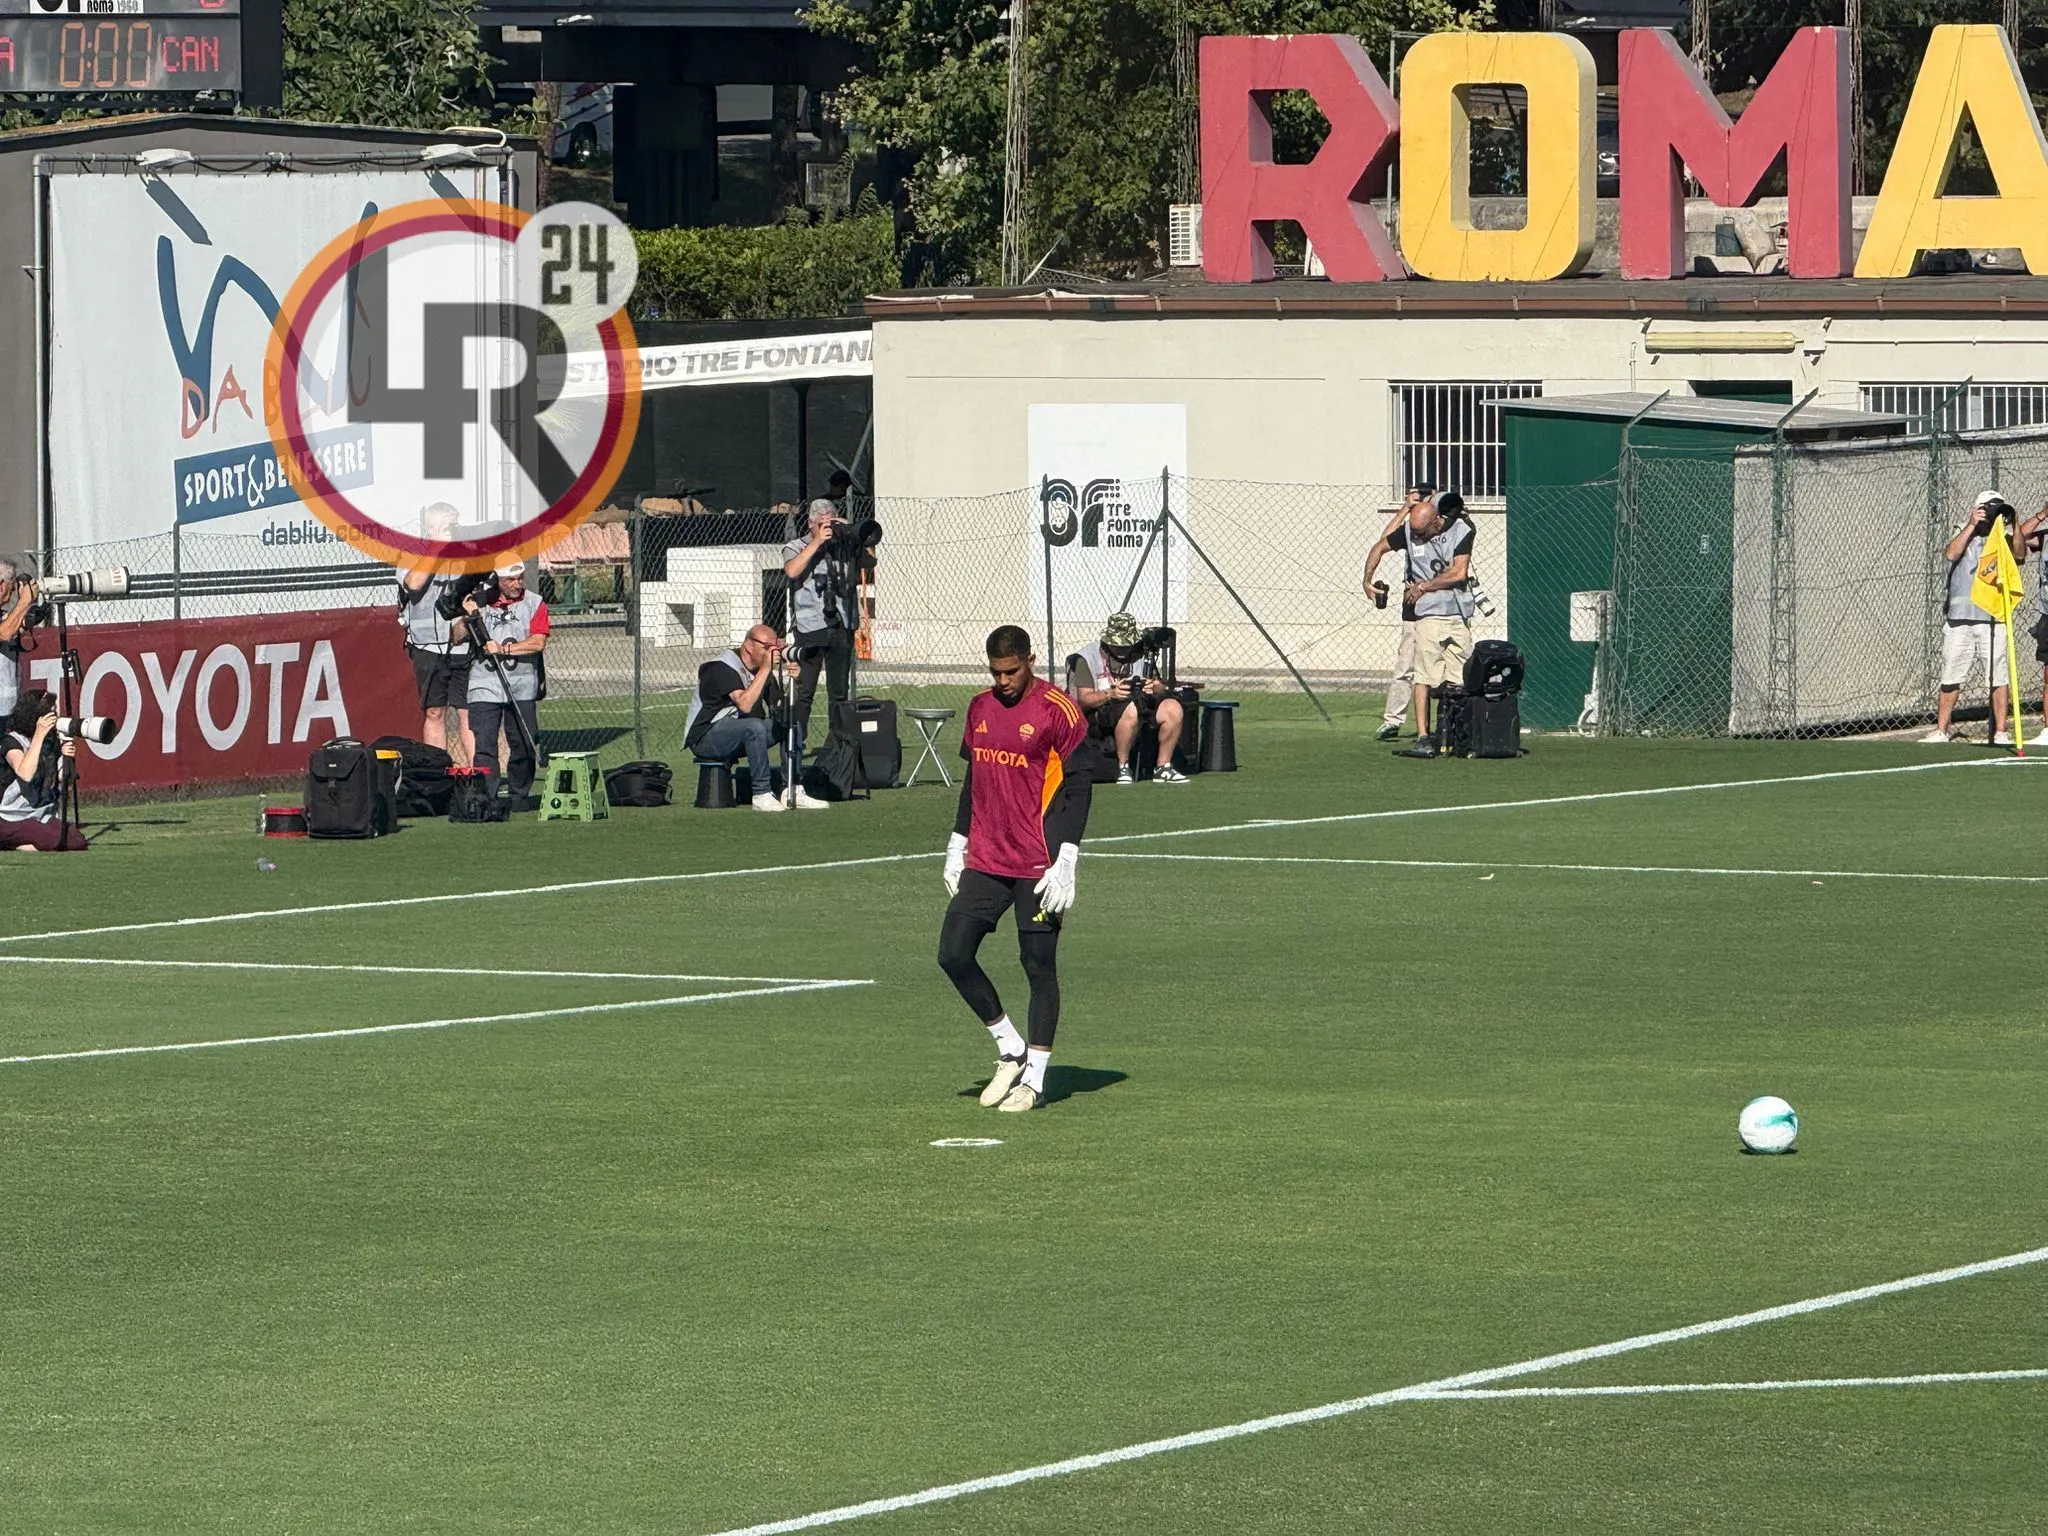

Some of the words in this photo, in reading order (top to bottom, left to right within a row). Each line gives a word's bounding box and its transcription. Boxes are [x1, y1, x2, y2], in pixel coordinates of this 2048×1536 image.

[60, 22, 152, 88] 0:00
[162, 36, 219, 72] CAN
[1199, 24, 2048, 283] ROMA
[682, 350, 739, 376] TRE
[30, 639, 352, 761] TOYOTA
[973, 747, 1030, 769] TOYOTA
